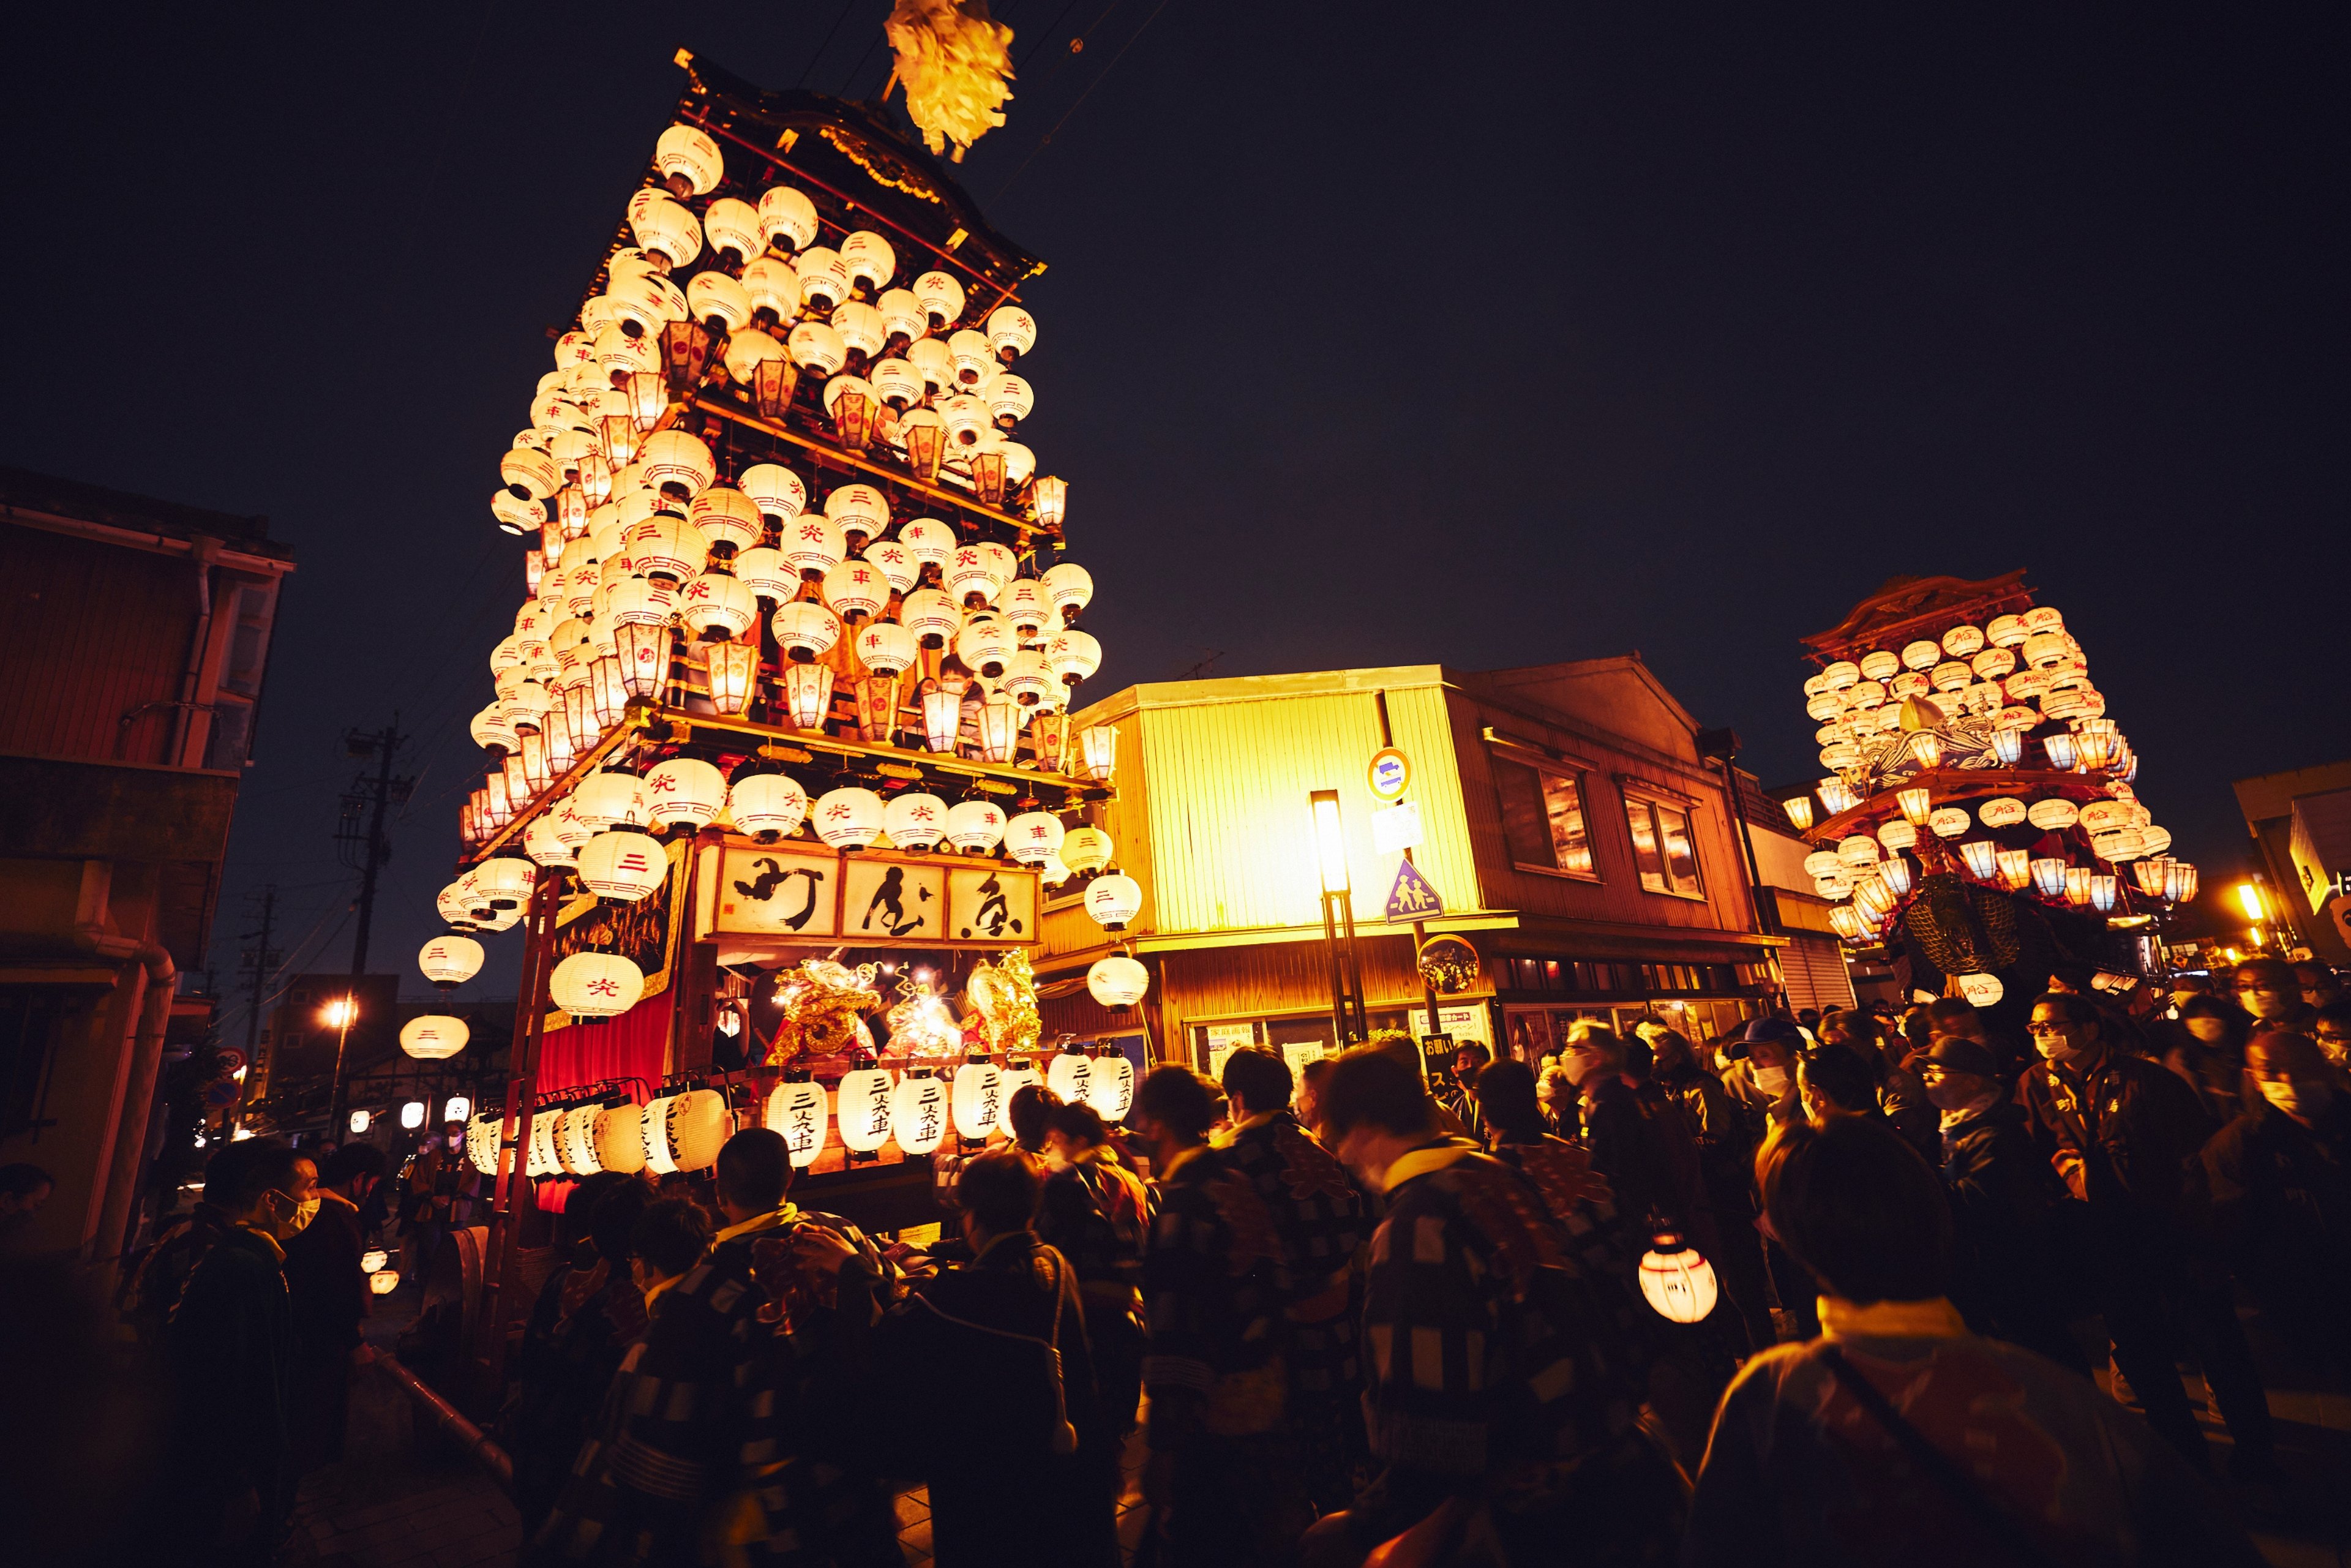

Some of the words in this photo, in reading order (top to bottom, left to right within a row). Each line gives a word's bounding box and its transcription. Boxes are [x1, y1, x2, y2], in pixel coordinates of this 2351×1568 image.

[634, 193, 650, 207] 三
[686, 225, 699, 248] 三
[849, 237, 866, 250] 三
[830, 261, 846, 279] 三
[576, 349, 591, 361] 車
[883, 365, 900, 375] 三
[1003, 383, 1020, 394] 三
[546, 406, 561, 418] 車
[850, 490, 872, 505] 三
[693, 498, 711, 514] 三
[637, 525, 662, 541] 三
[909, 527, 924, 539] 車
[779, 560, 798, 577] 三
[853, 569, 870, 584] 車
[648, 591, 672, 606] 三
[1016, 588, 1035, 601] 三
[937, 596, 956, 610] 三
[520, 617, 535, 631] 車
[865, 634, 882, 648] 車
[500, 647, 517, 659] 三
[531, 647, 544, 658] 車
[564, 655, 580, 671] 三
[502, 690, 517, 703] 三
[984, 812, 998, 825] 車
[1030, 825, 1046, 839] 車
[1079, 836, 1097, 847] 三
[618, 853, 648, 872] 三
[1095, 889, 1114, 903] 三
[428, 948, 447, 959] 三
[416, 1030, 438, 1040] 三
[1210, 1026, 1251, 1037] 家庭画報
[1425, 1038, 1453, 1056] お願い
